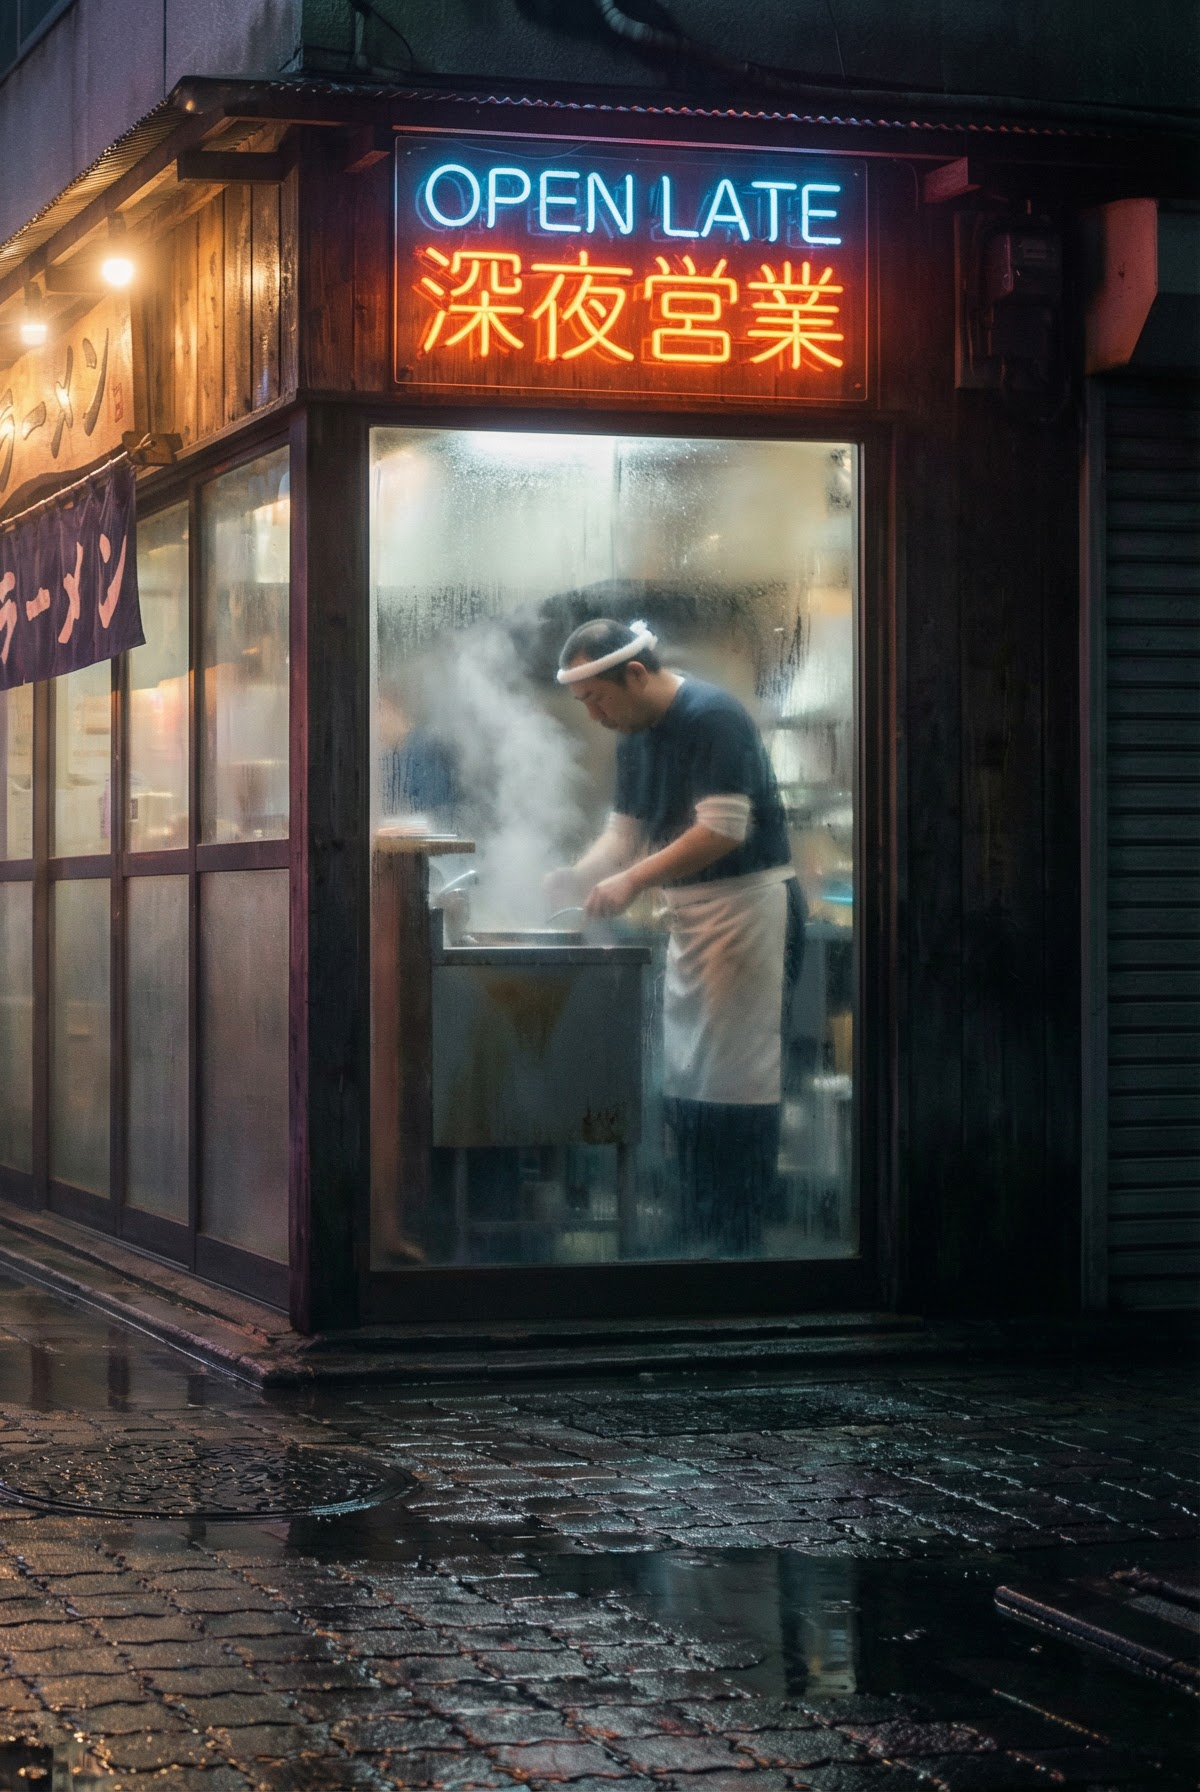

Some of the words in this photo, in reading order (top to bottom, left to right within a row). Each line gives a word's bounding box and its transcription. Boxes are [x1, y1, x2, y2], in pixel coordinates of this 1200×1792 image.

[422, 162, 635, 236] OPEN
[661, 176, 844, 246] LATE
[416, 244, 846, 370] 深夜営業
